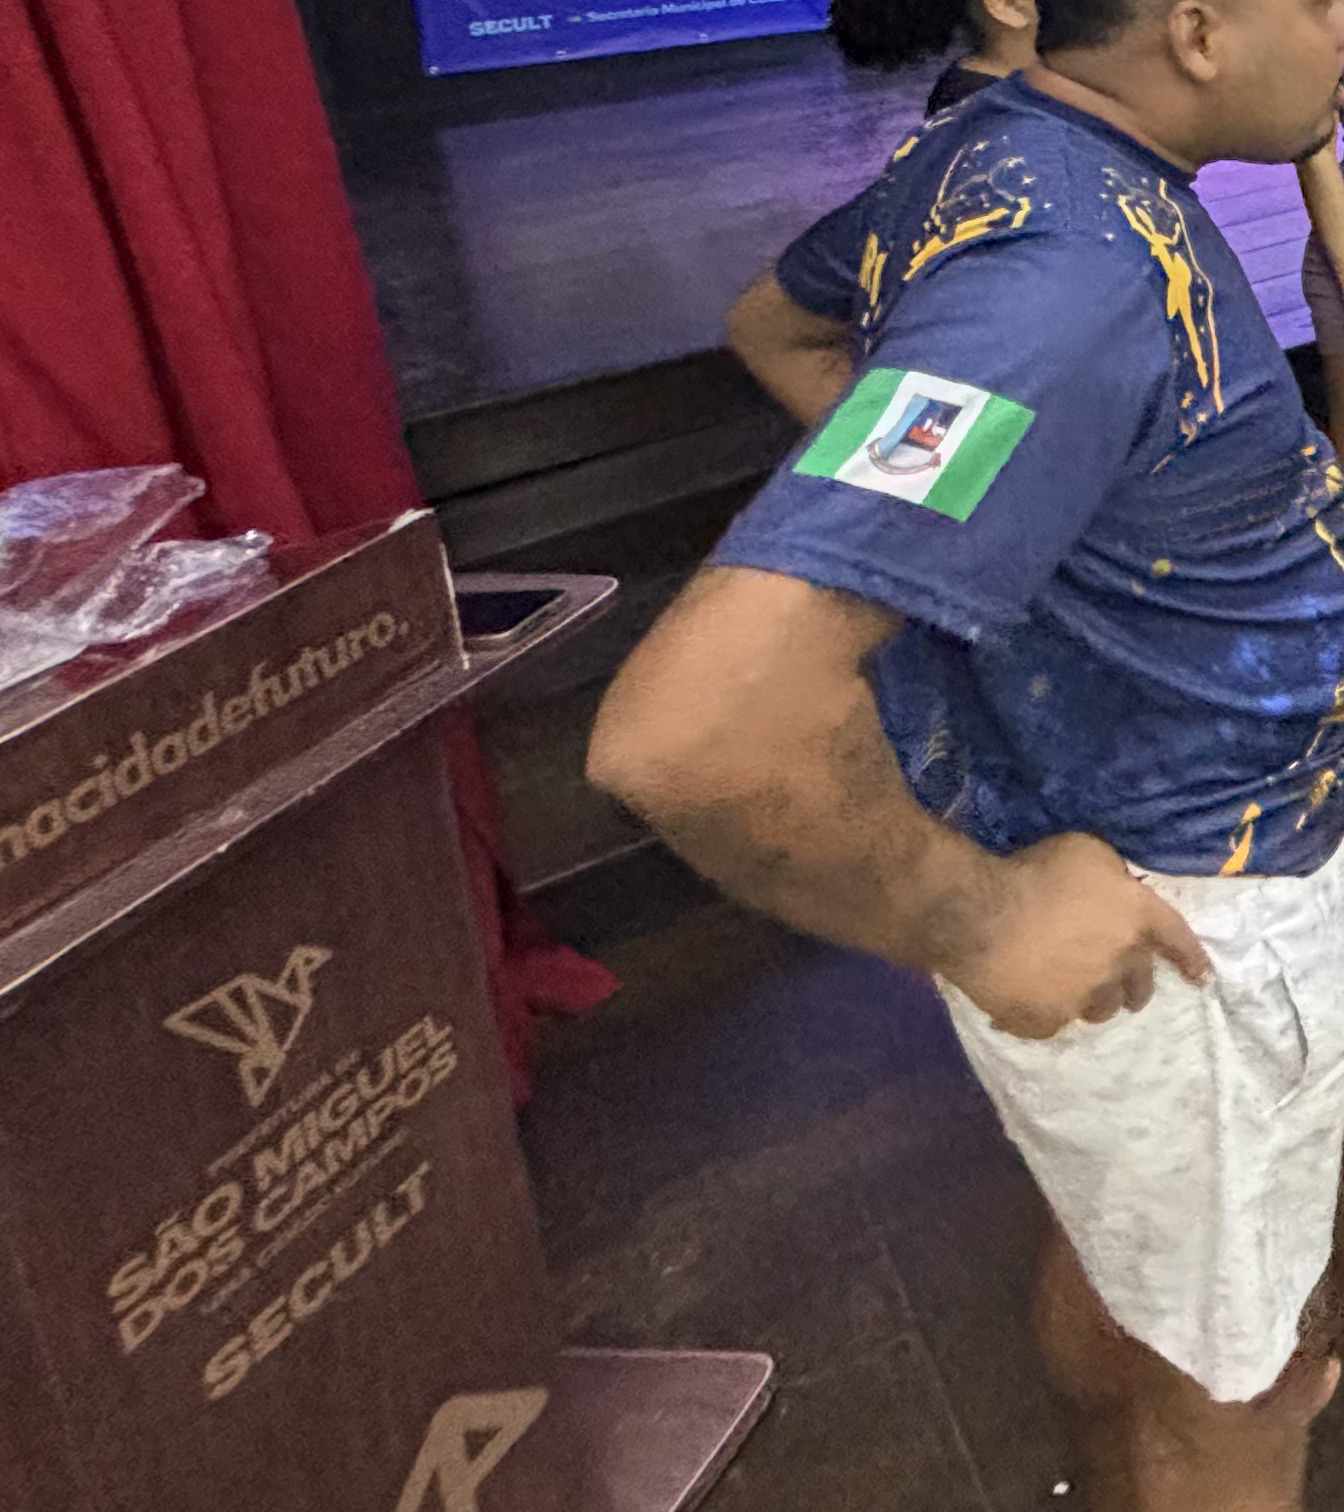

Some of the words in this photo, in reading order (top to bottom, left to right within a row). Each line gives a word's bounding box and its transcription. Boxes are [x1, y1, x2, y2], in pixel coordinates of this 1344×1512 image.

[469, 14, 553, 37] SECULT
[106, 1182, 243, 1314] SÃO
[253, 1015, 454, 1192] MIGUEL
[118, 1223, 246, 1354] DOS
[254, 1042, 458, 1232] CAMPOS
[204, 1160, 433, 1399] SECULT
